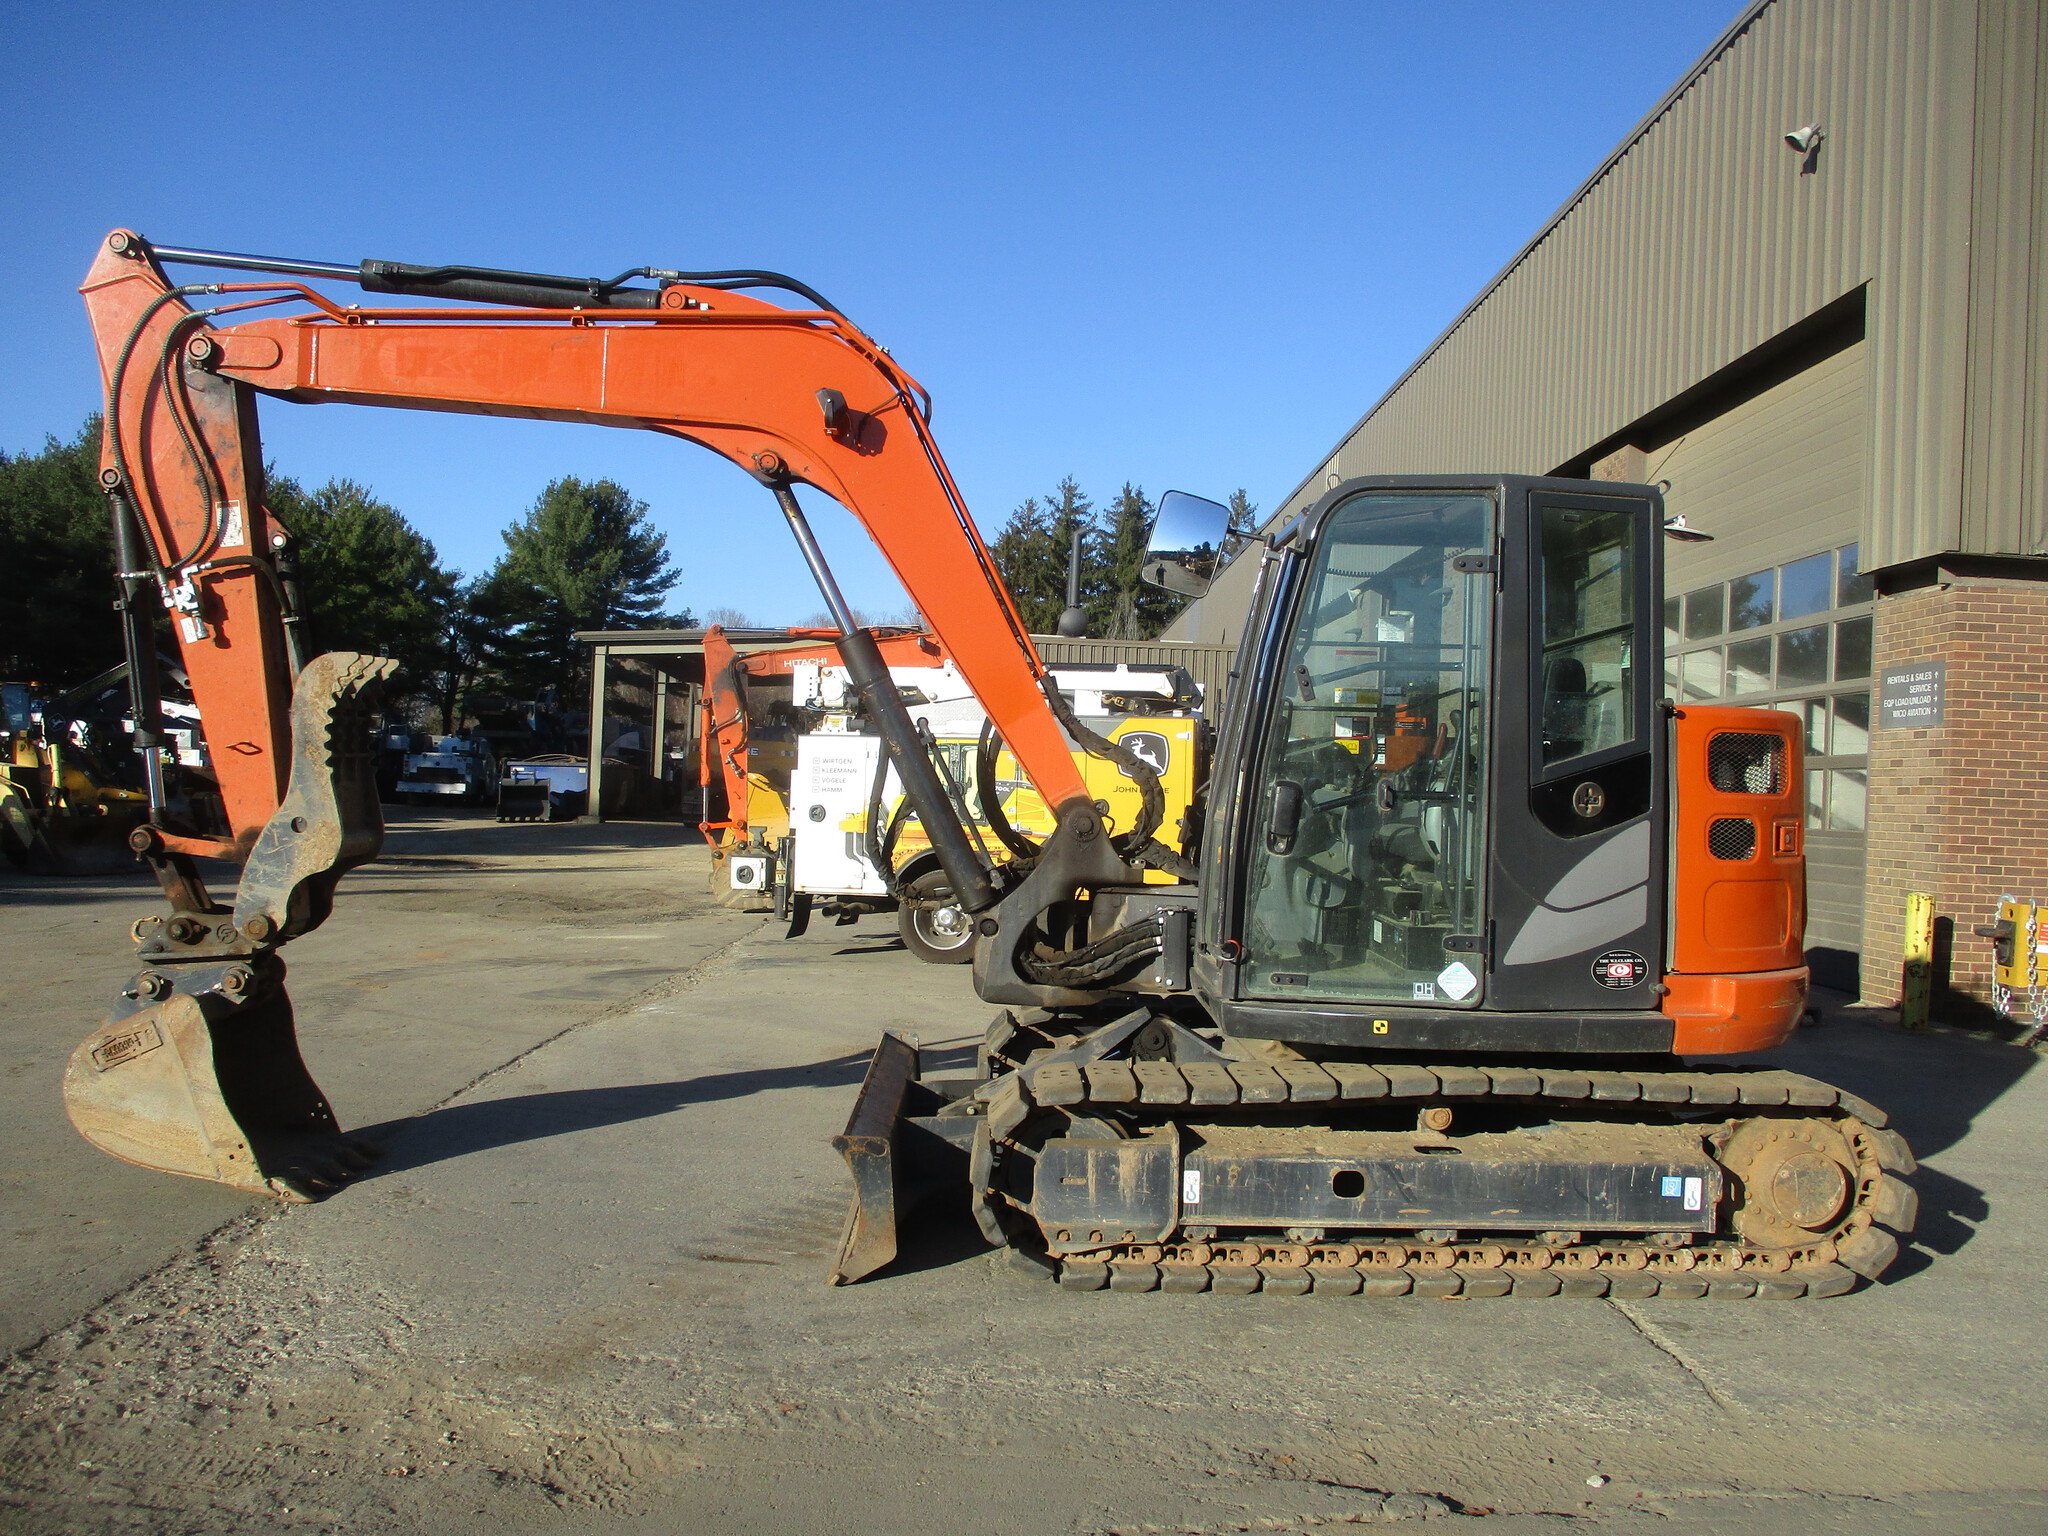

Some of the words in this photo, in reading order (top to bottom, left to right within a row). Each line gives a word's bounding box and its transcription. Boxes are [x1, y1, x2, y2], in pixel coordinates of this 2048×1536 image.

[783, 657, 828, 668] HITACHI
[1887, 674, 1910, 685] RENTALS
[1915, 671, 1932, 681] SALES
[1909, 683, 1932, 694] SERVICE
[1113, 785, 1138, 793] JOHN
